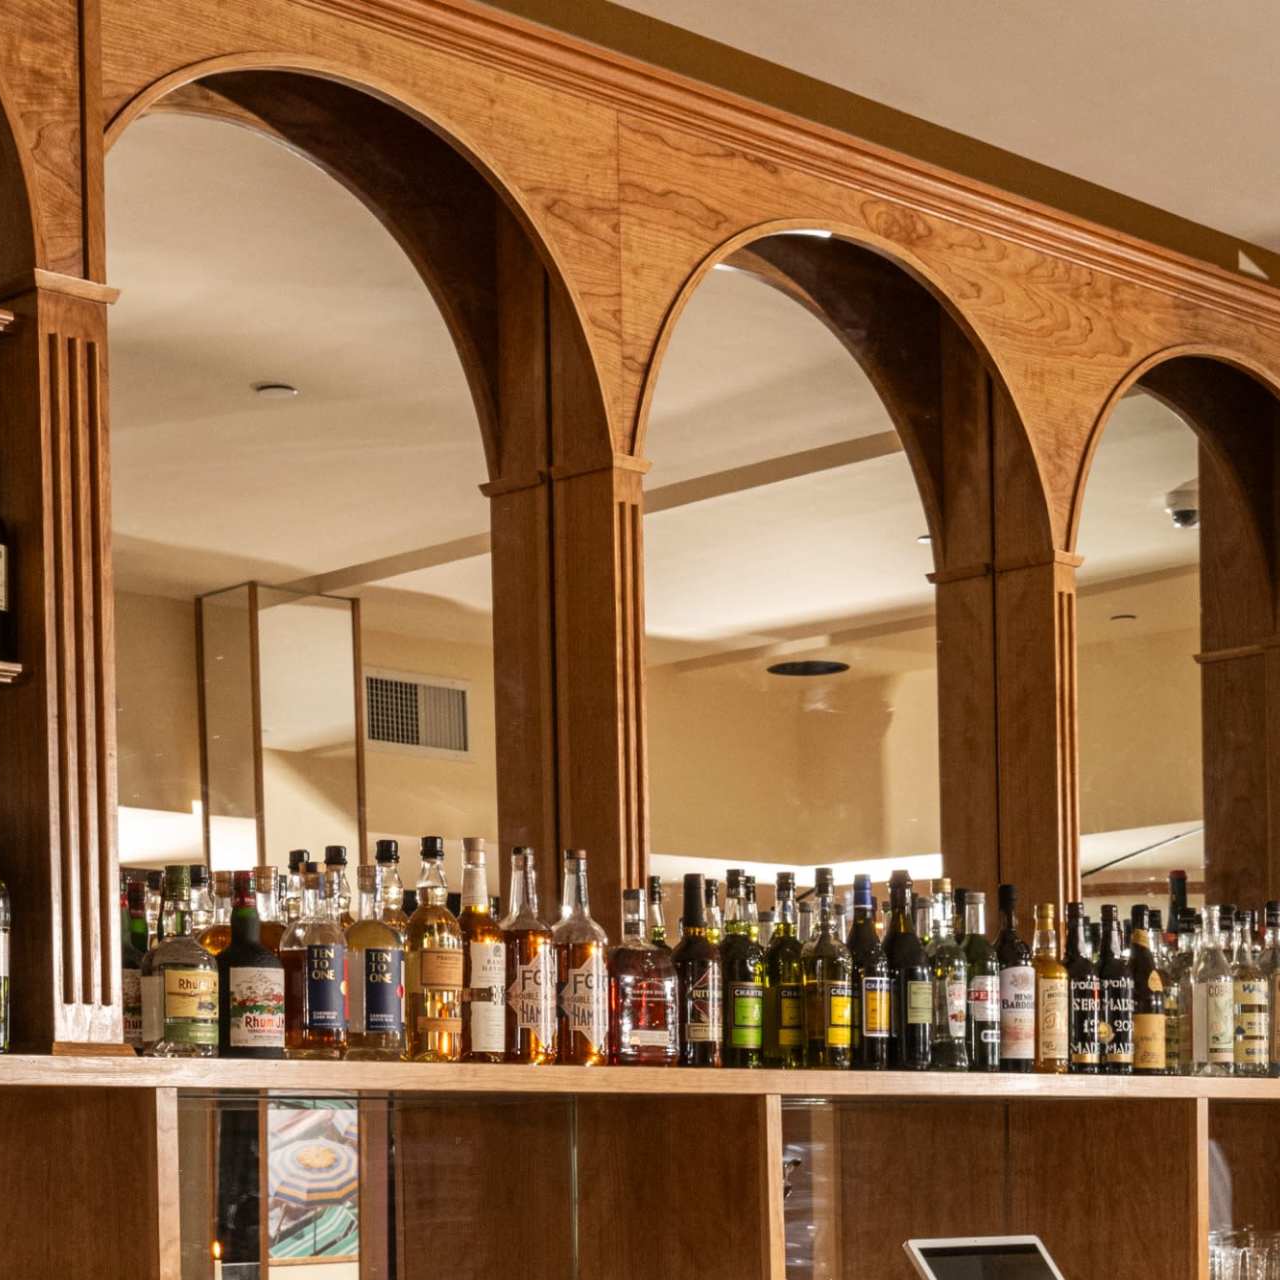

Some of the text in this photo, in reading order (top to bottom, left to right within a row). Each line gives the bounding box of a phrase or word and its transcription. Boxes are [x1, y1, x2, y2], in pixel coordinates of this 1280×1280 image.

[312, 948, 335, 959] TEN
[370, 952, 392, 962] TEN
[312, 960, 329, 969] TO
[370, 963, 386, 972] TO
[312, 970, 335, 980] ONE
[370, 973, 392, 984] ONE
